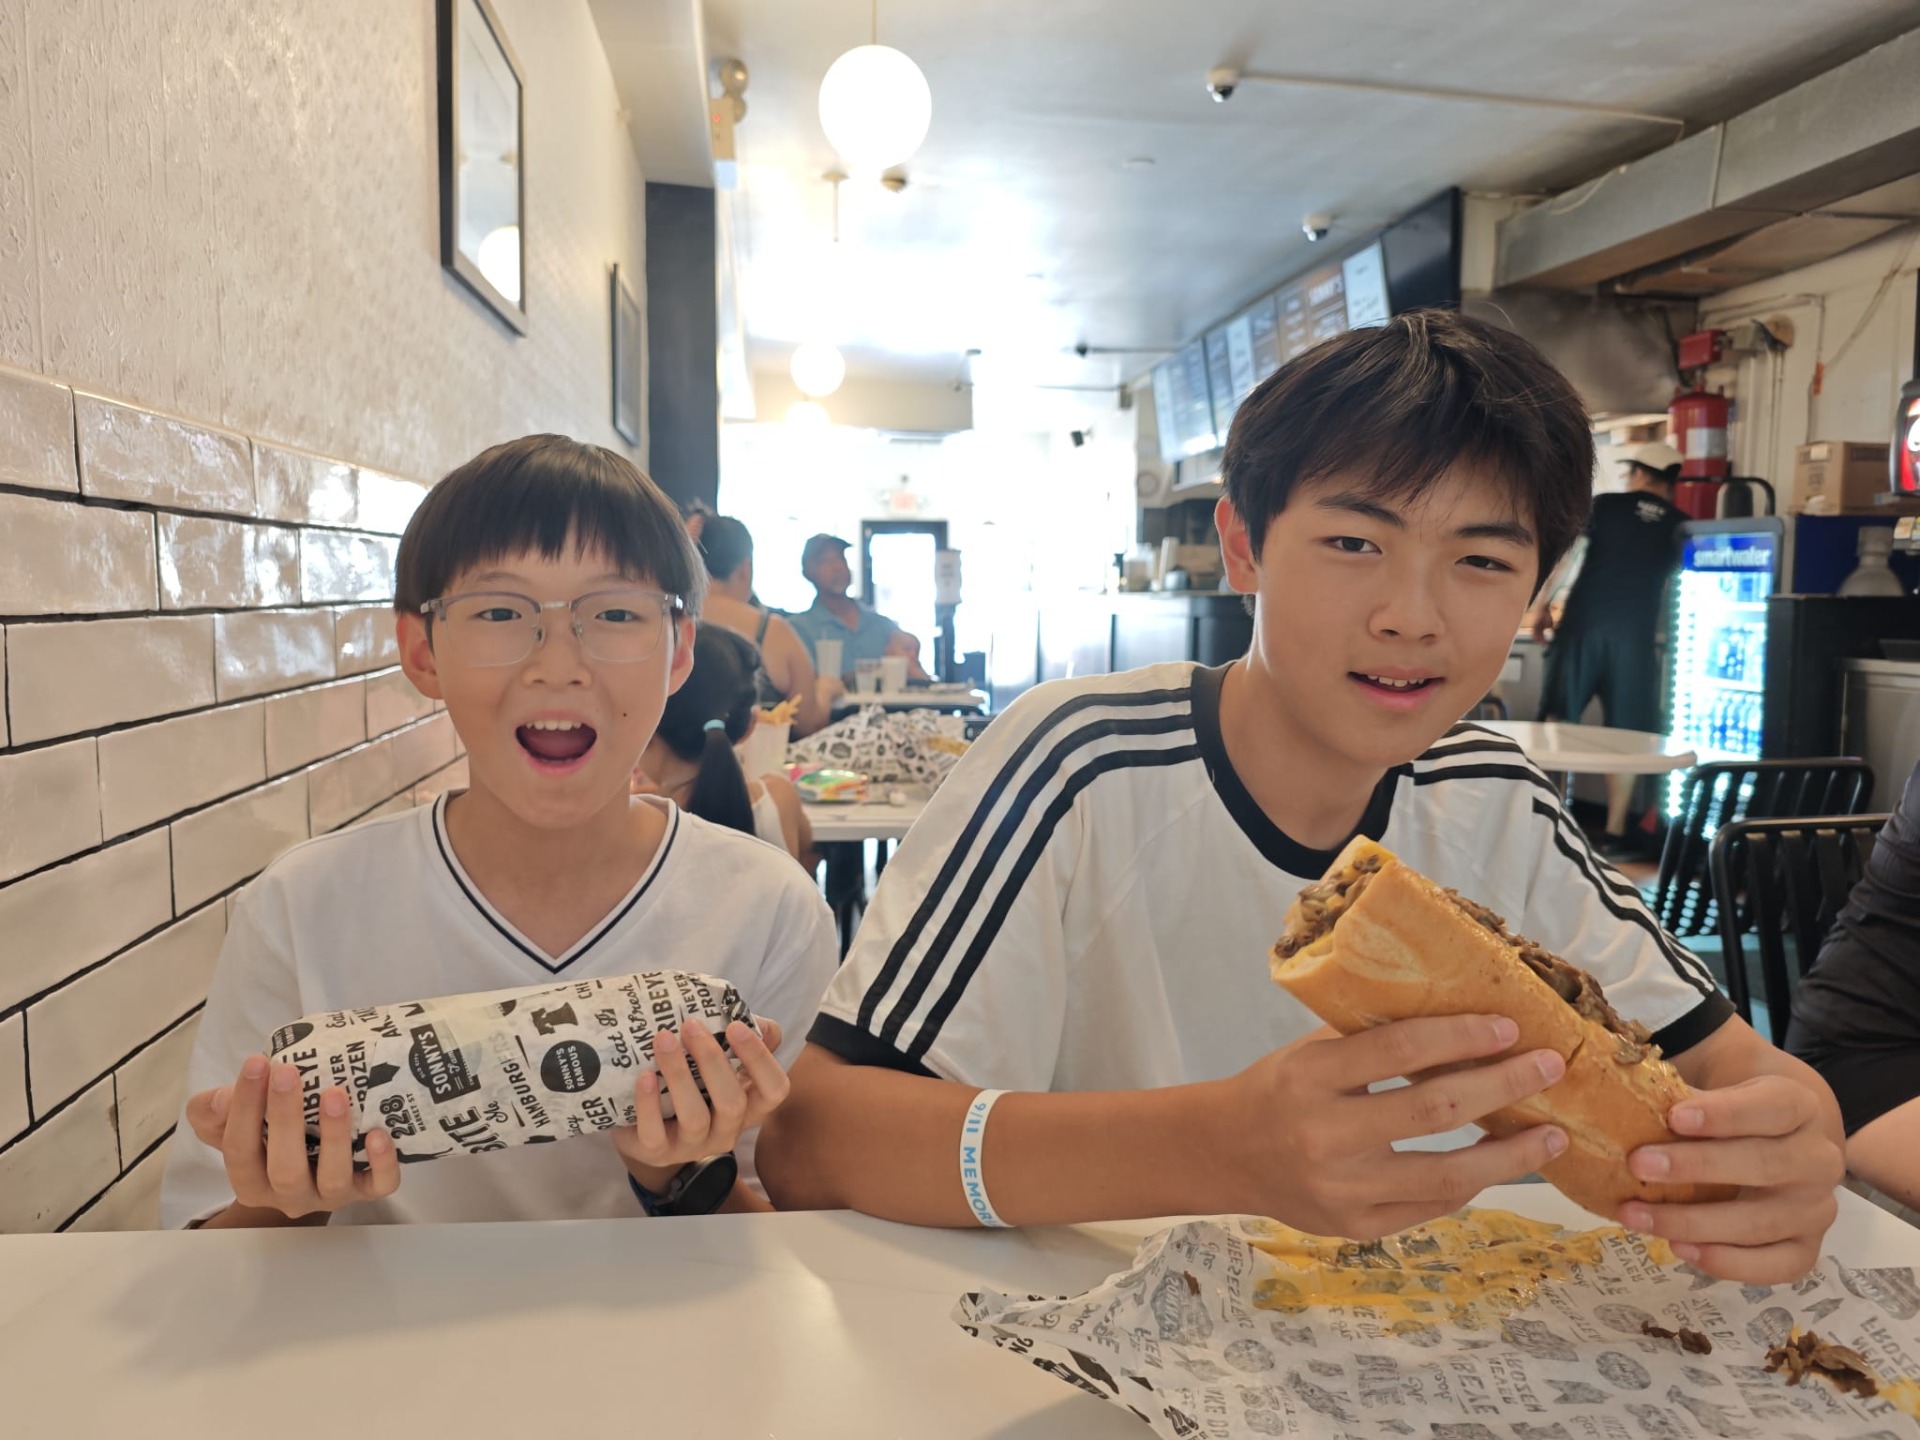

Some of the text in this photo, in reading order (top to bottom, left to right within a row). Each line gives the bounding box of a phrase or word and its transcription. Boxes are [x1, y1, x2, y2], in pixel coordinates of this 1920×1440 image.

[674, 974, 699, 1014] NEVER
[418, 1030, 451, 1095] SONNY'S
[556, 1047, 575, 1090] SONNY'S
[568, 1045, 586, 1087] FAMOUS
[608, 1031, 632, 1069] Eat
[380, 1094, 417, 1140] 228
[406, 1093, 427, 1132] MARKET ST
[966, 1103, 987, 1133] 9/11
